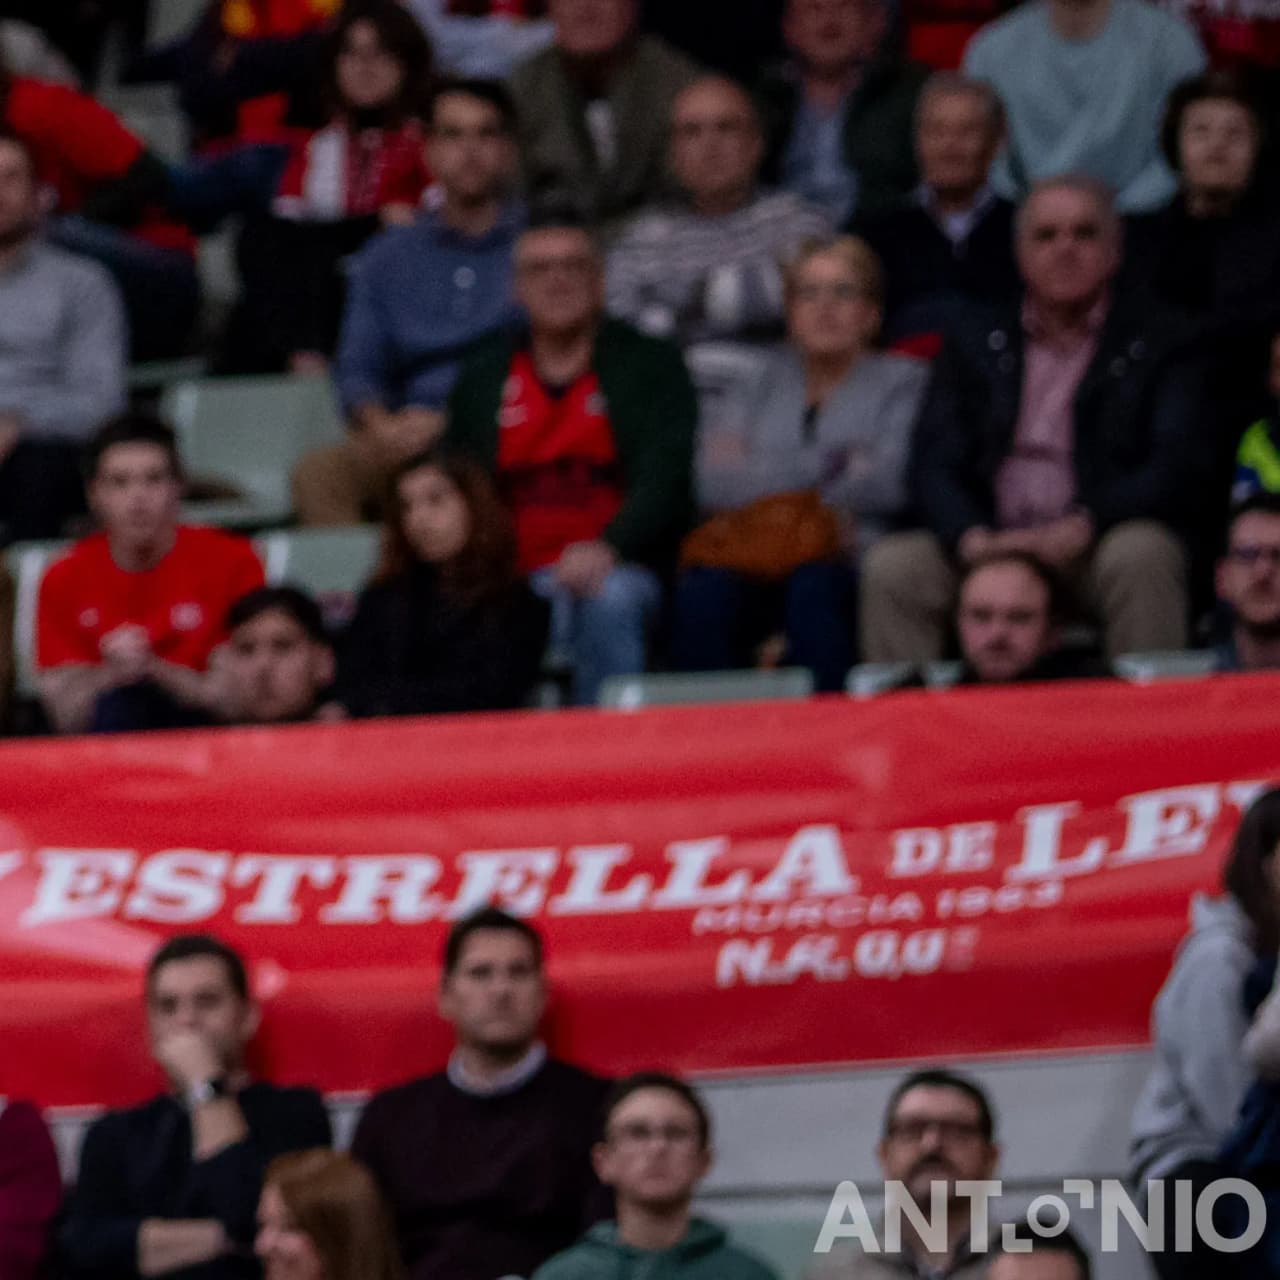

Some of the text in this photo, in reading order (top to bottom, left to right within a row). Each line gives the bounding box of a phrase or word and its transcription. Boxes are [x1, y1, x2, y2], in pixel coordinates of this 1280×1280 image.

[20, 822, 860, 926] ESTRELLA
[887, 821, 998, 880] DE
[692, 891, 924, 934] MURCIA
